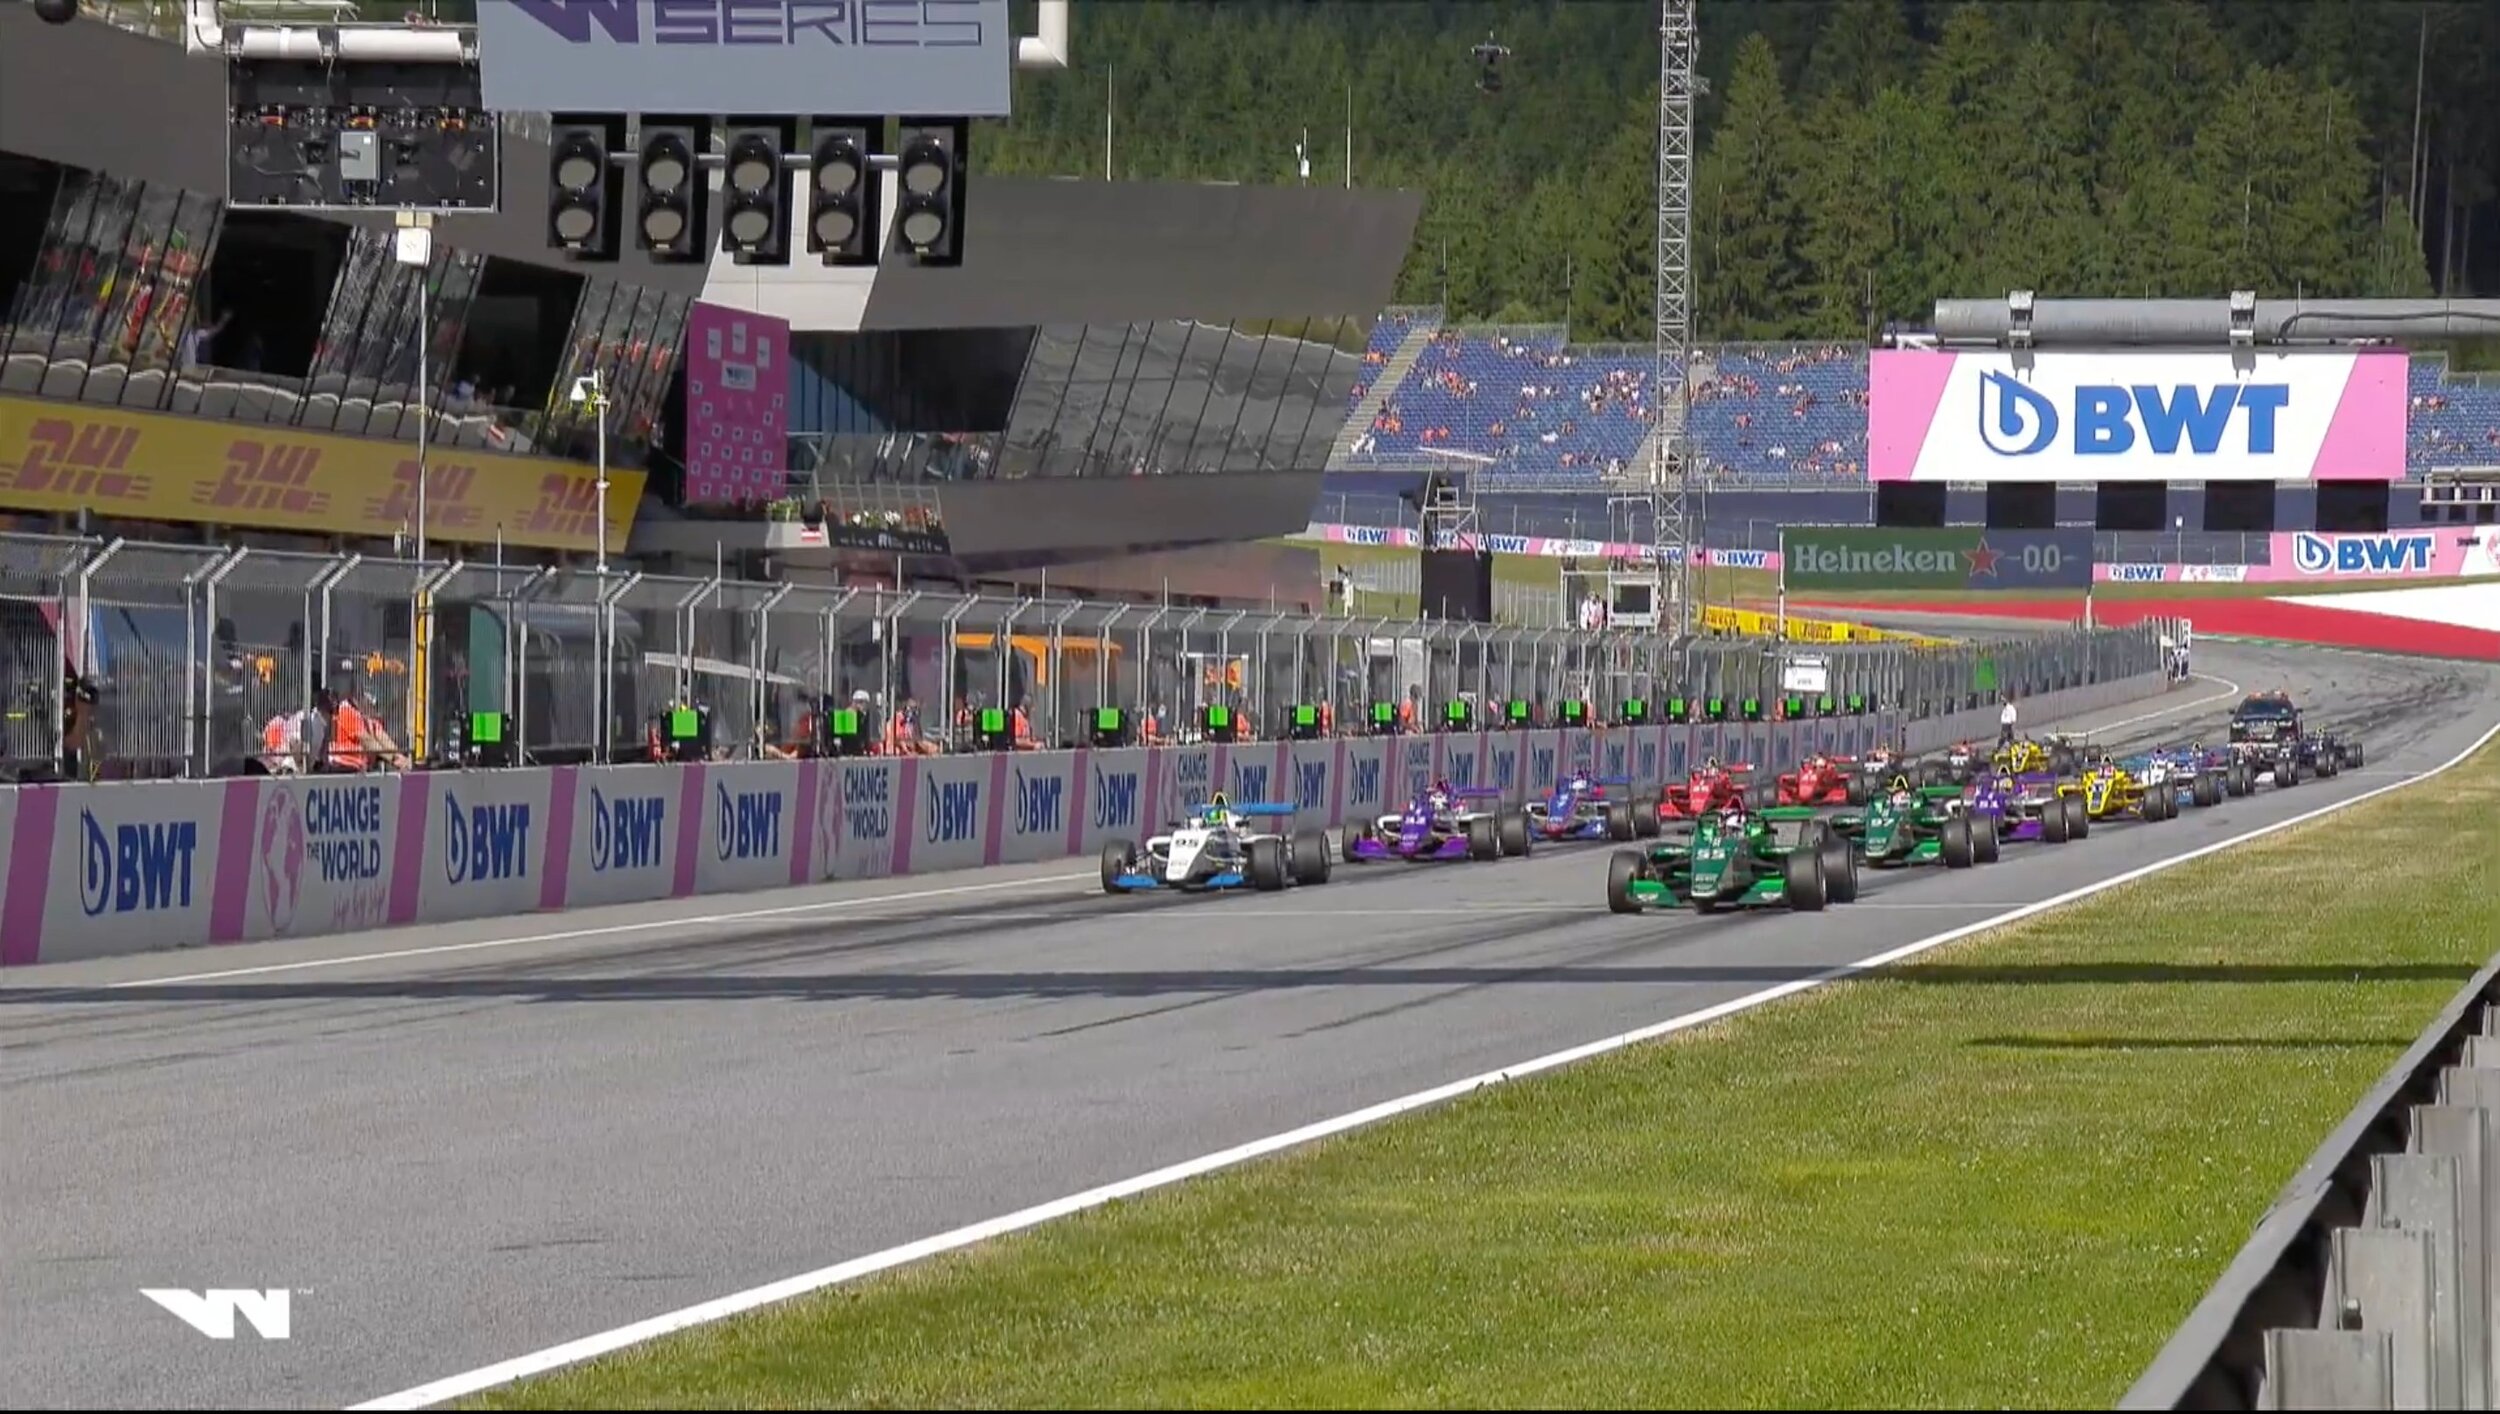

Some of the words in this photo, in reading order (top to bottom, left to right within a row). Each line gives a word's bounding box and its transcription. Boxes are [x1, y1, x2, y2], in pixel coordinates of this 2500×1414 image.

[655, 0, 981, 46] SERIES
[2074, 384, 2289, 455] BWT
[14, 417, 141, 494] DHL
[212, 440, 320, 514] DHL
[1727, 551, 1765, 567] BWT
[1794, 544, 1957, 573] Heineken
[2124, 566, 2165, 580] BWT
[2337, 537, 2432, 571] BWT
[844, 767, 889, 805] CHANGE
[1029, 776, 1062, 831] BWT
[1108, 773, 1137, 827] BWT
[1243, 765, 1267, 804] BWT
[1303, 762, 1326, 808] BWT
[1359, 759, 1379, 803] BWT
[306, 787, 380, 835] CHANGE
[614, 797, 664, 868] BWT
[737, 792, 781, 858] BWT
[852, 806, 888, 841] WORLD
[942, 781, 978, 839] BWT
[321, 839, 381, 882] WORLD
[472, 804, 529, 880] BWT
[1175, 838, 1199, 847] 95
[116, 821, 196, 912] BWT
